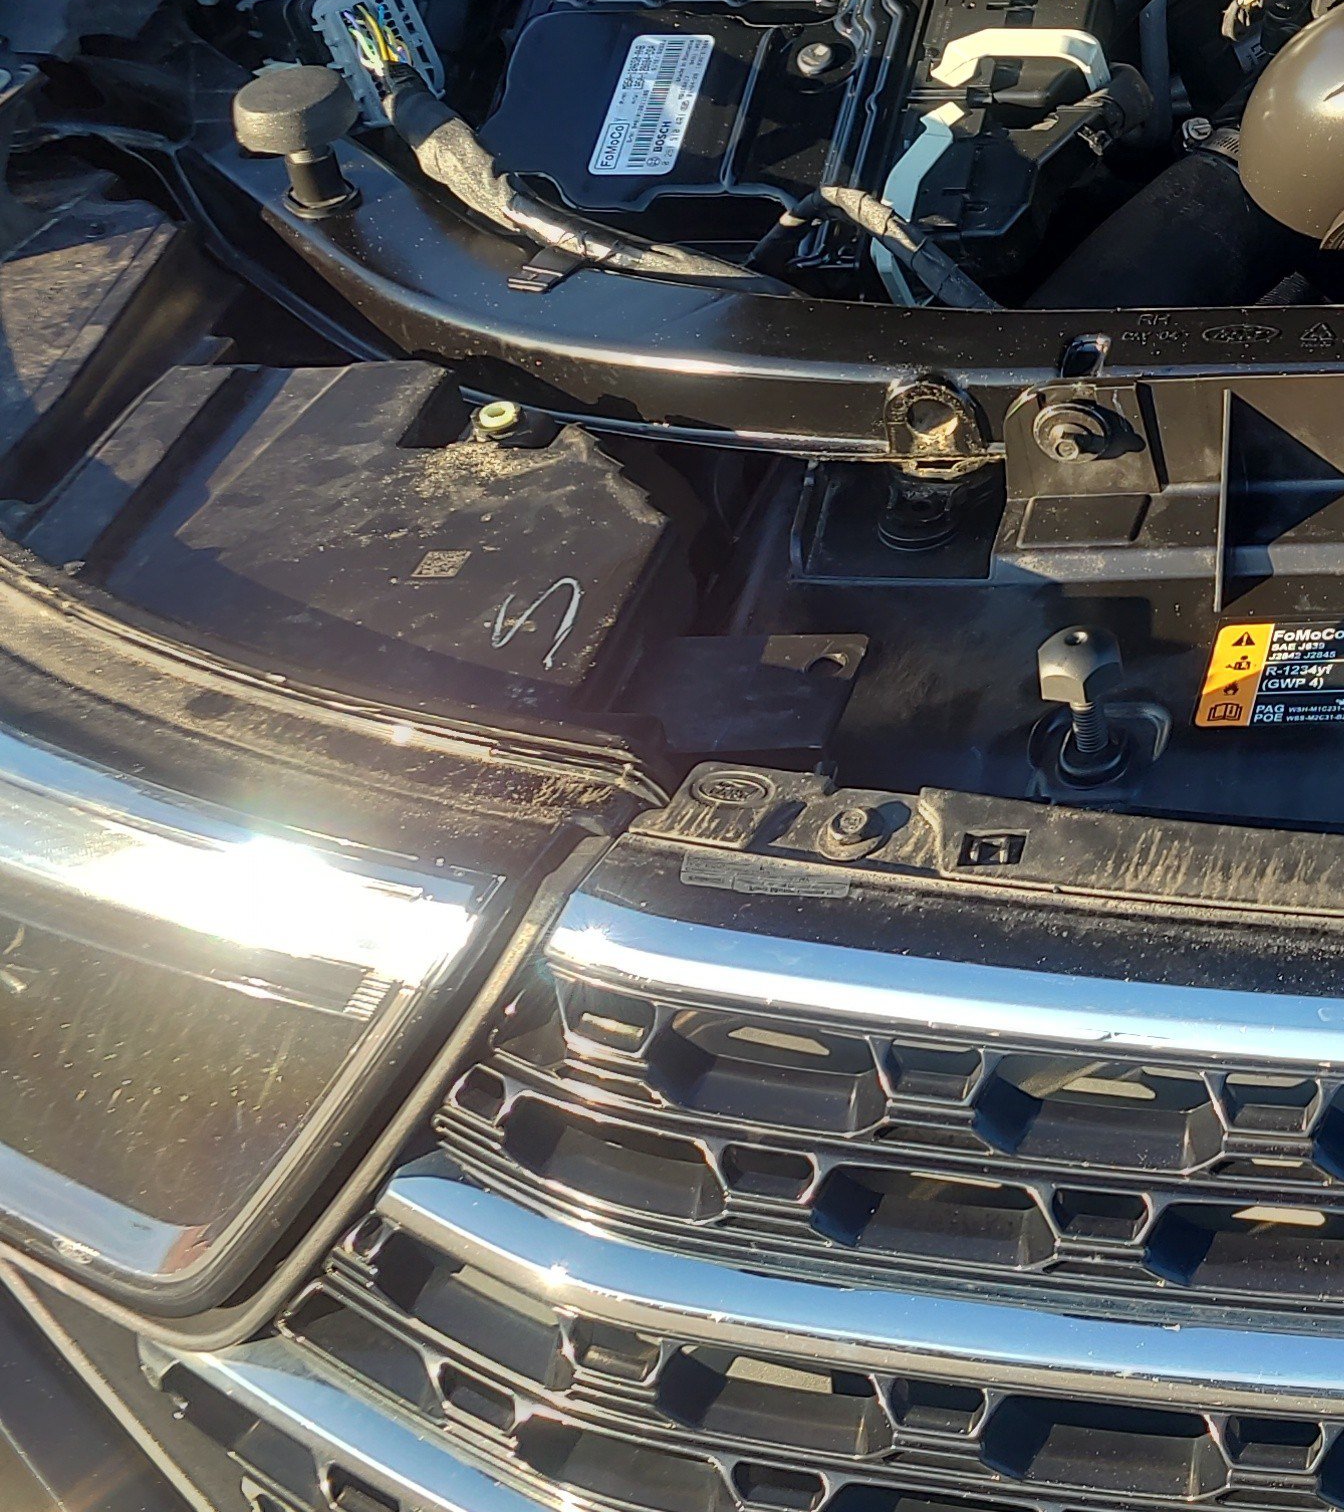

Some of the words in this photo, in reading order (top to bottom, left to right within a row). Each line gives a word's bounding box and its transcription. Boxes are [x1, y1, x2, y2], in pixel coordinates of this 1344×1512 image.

[652, 121, 672, 153] BOSCH
[600, 125, 624, 167] FoMoCo
[1271, 643, 1296, 651] SAE
[1298, 642, 1325, 651] J639
[1265, 663, 1334, 676] R-1234yf
[1262, 678, 1306, 691] (GWP
[1309, 678, 1324, 689] 4)
[1256, 704, 1285, 713] PAG
[1253, 713, 1284, 722] POE
